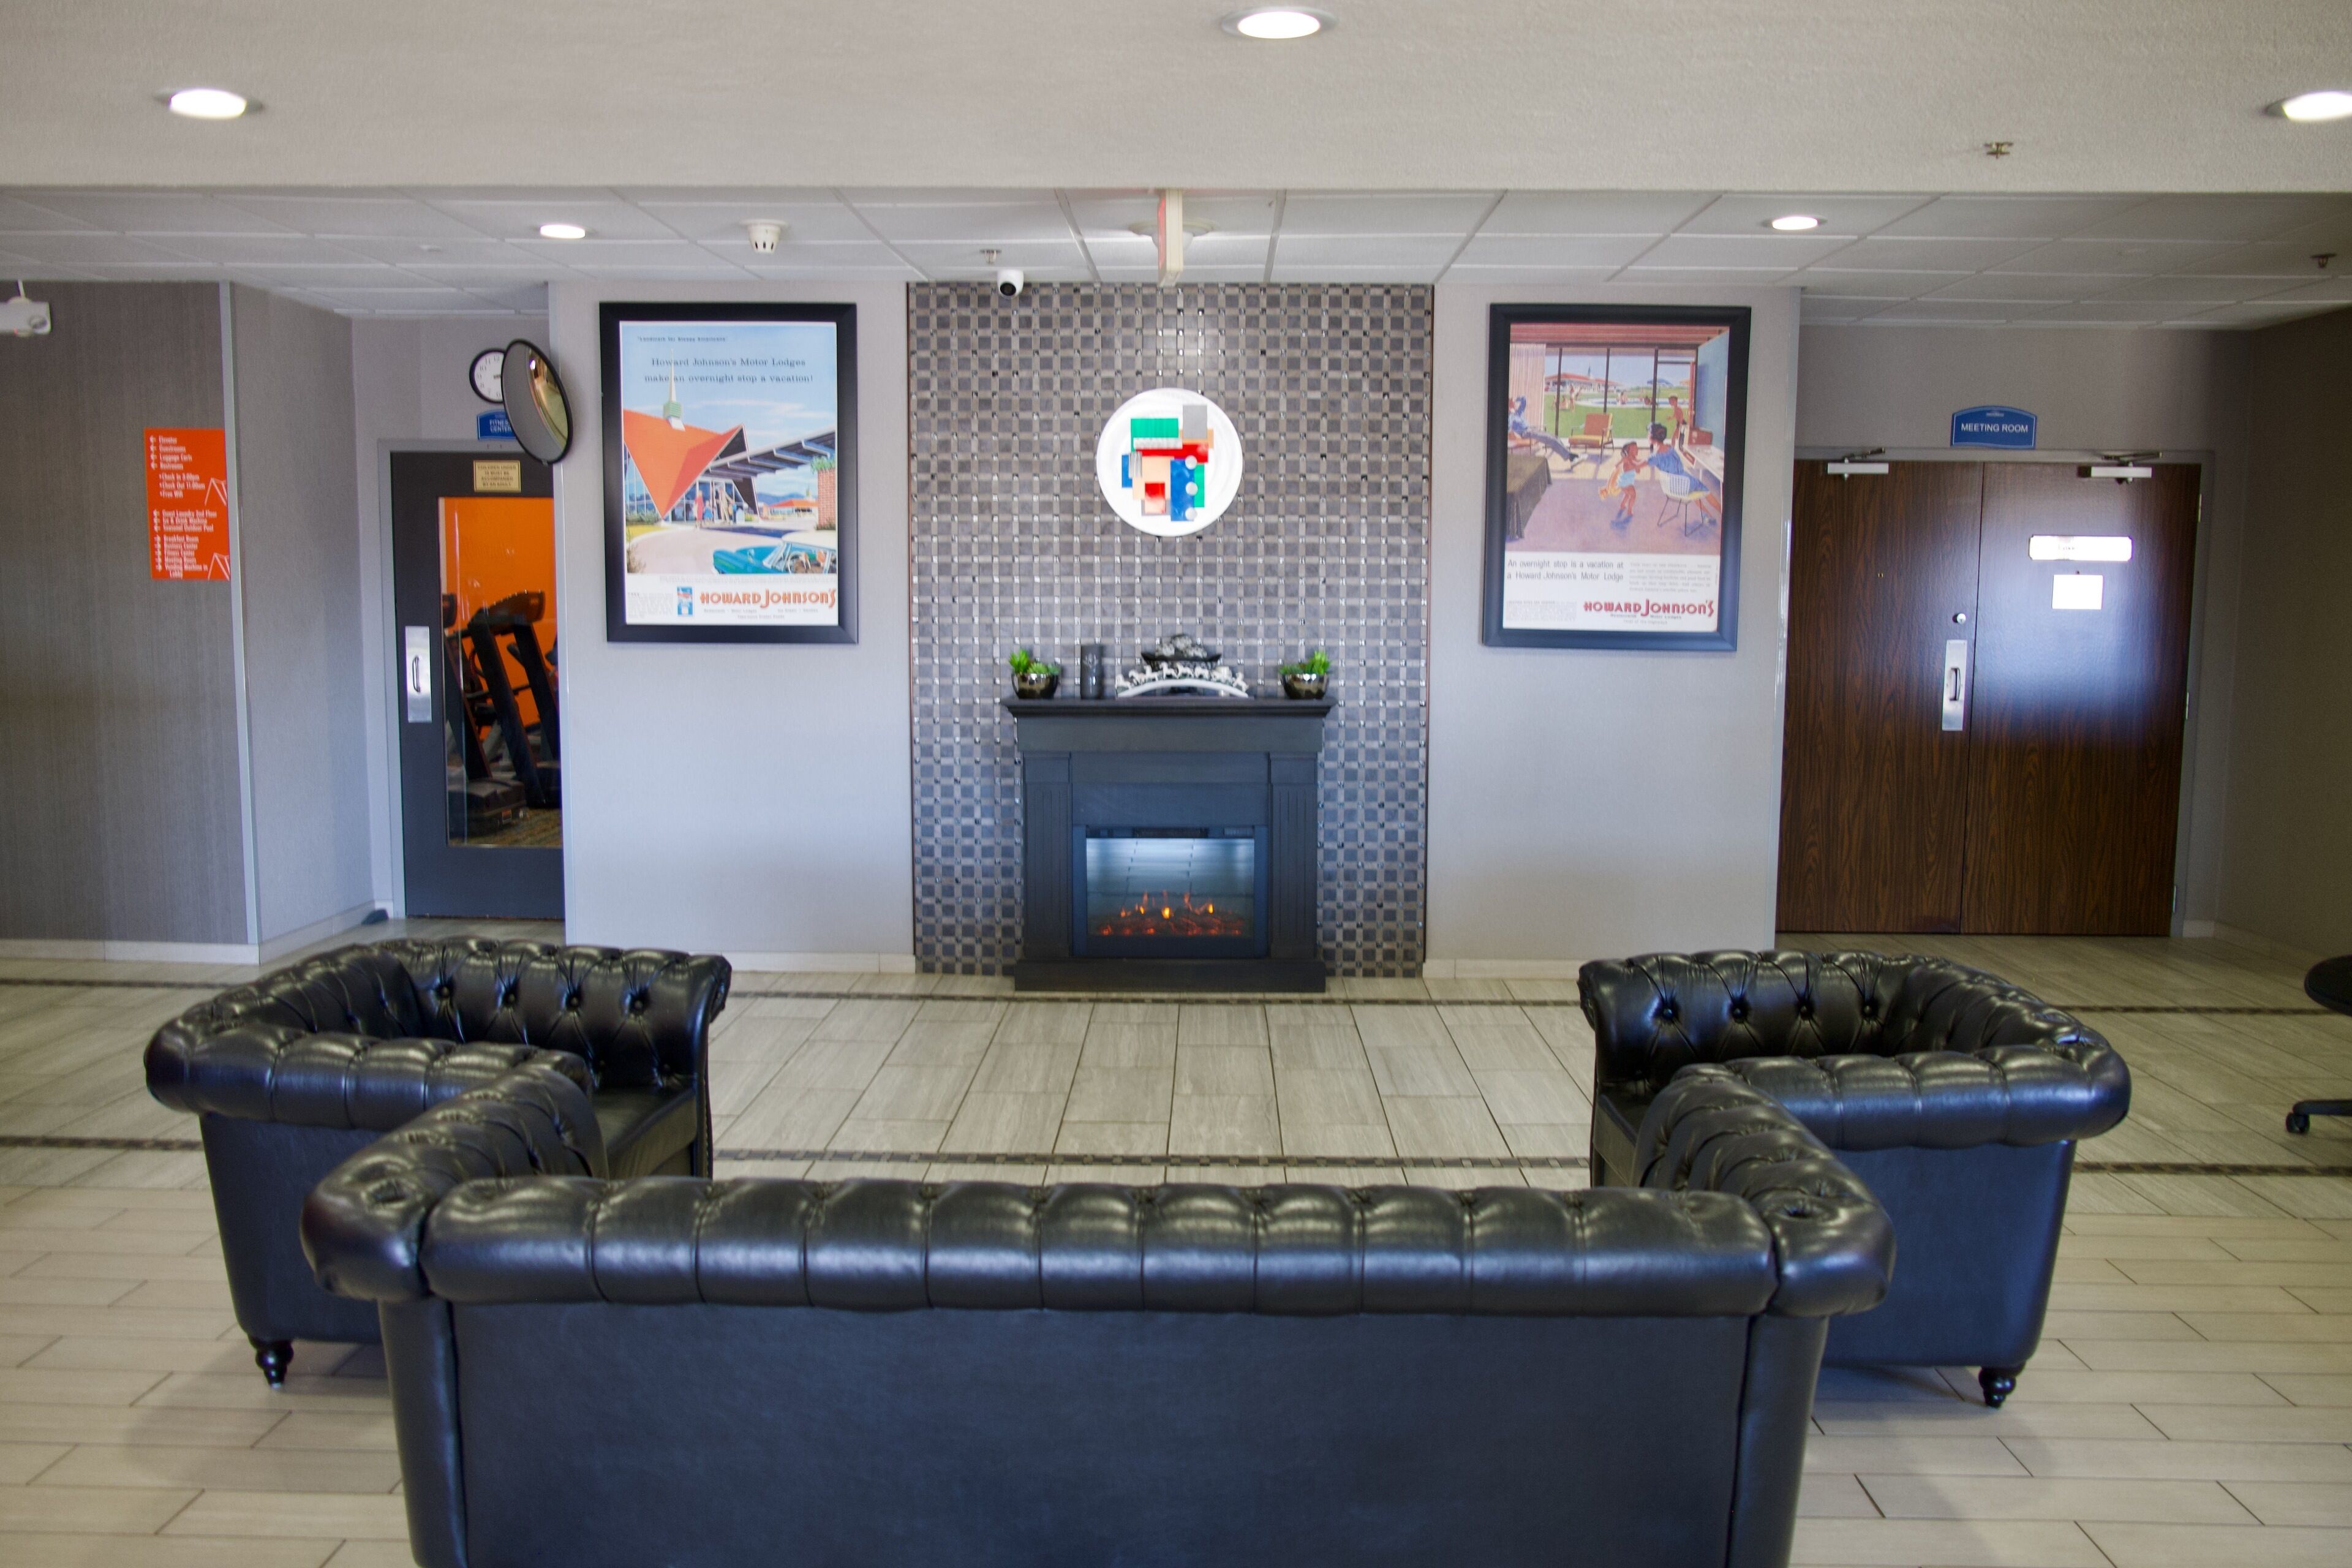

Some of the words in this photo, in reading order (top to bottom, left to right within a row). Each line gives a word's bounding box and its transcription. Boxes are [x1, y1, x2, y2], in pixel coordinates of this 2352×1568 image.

[652, 358, 689, 366] Howard
[693, 358, 737, 366] Johnson's
[741, 358, 768, 366] Motor
[772, 358, 806, 369] Lodges
[645, 374, 669, 382] make
[688, 374, 734, 385] overnight
[737, 374, 757, 384] stop
[769, 374, 813, 383] vacation!
[1961, 423, 1999, 432] MEETING
[2002, 423, 2028, 433] ROOM
[160, 453, 180, 462] Luggage
[181, 453, 192, 462] Carts
[1508, 559, 1517, 568] An
[1520, 560, 1550, 570] overnight
[1553, 560, 1567, 569] stop
[1604, 572, 1624, 582] Lodge
[699, 590, 762, 604] HOWARD
[1583, 601, 1642, 612] HOWARD
